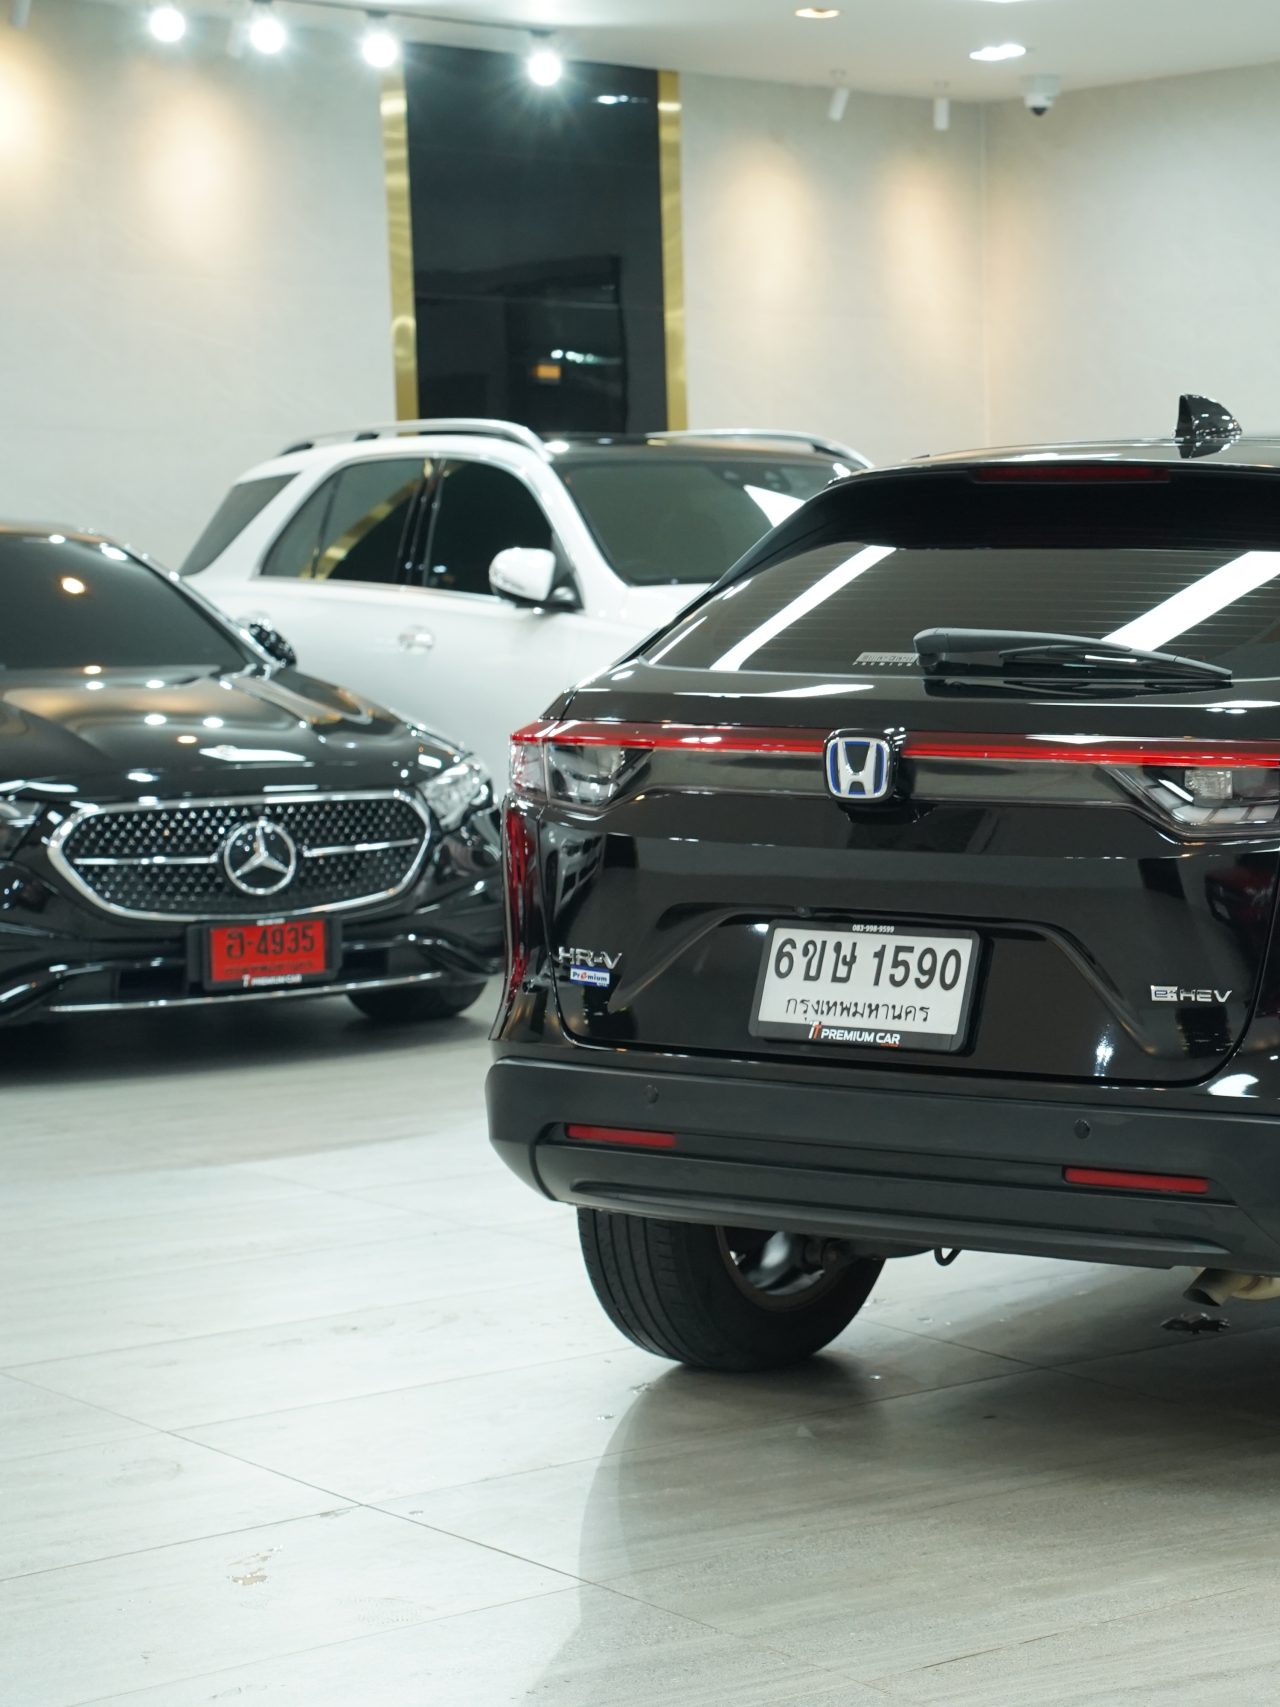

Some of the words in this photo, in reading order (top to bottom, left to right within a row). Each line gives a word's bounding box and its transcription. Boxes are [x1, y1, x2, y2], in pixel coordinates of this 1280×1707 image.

[558, 946, 622, 969] HR-V
[774, 937, 857, 984] 6ขษ
[872, 943, 962, 991] 1590
[785, 997, 930, 1022] กรุงเทพมหานคร
[820, 1028, 874, 1043] PREMIUM
[876, 1032, 900, 1045] CAR
